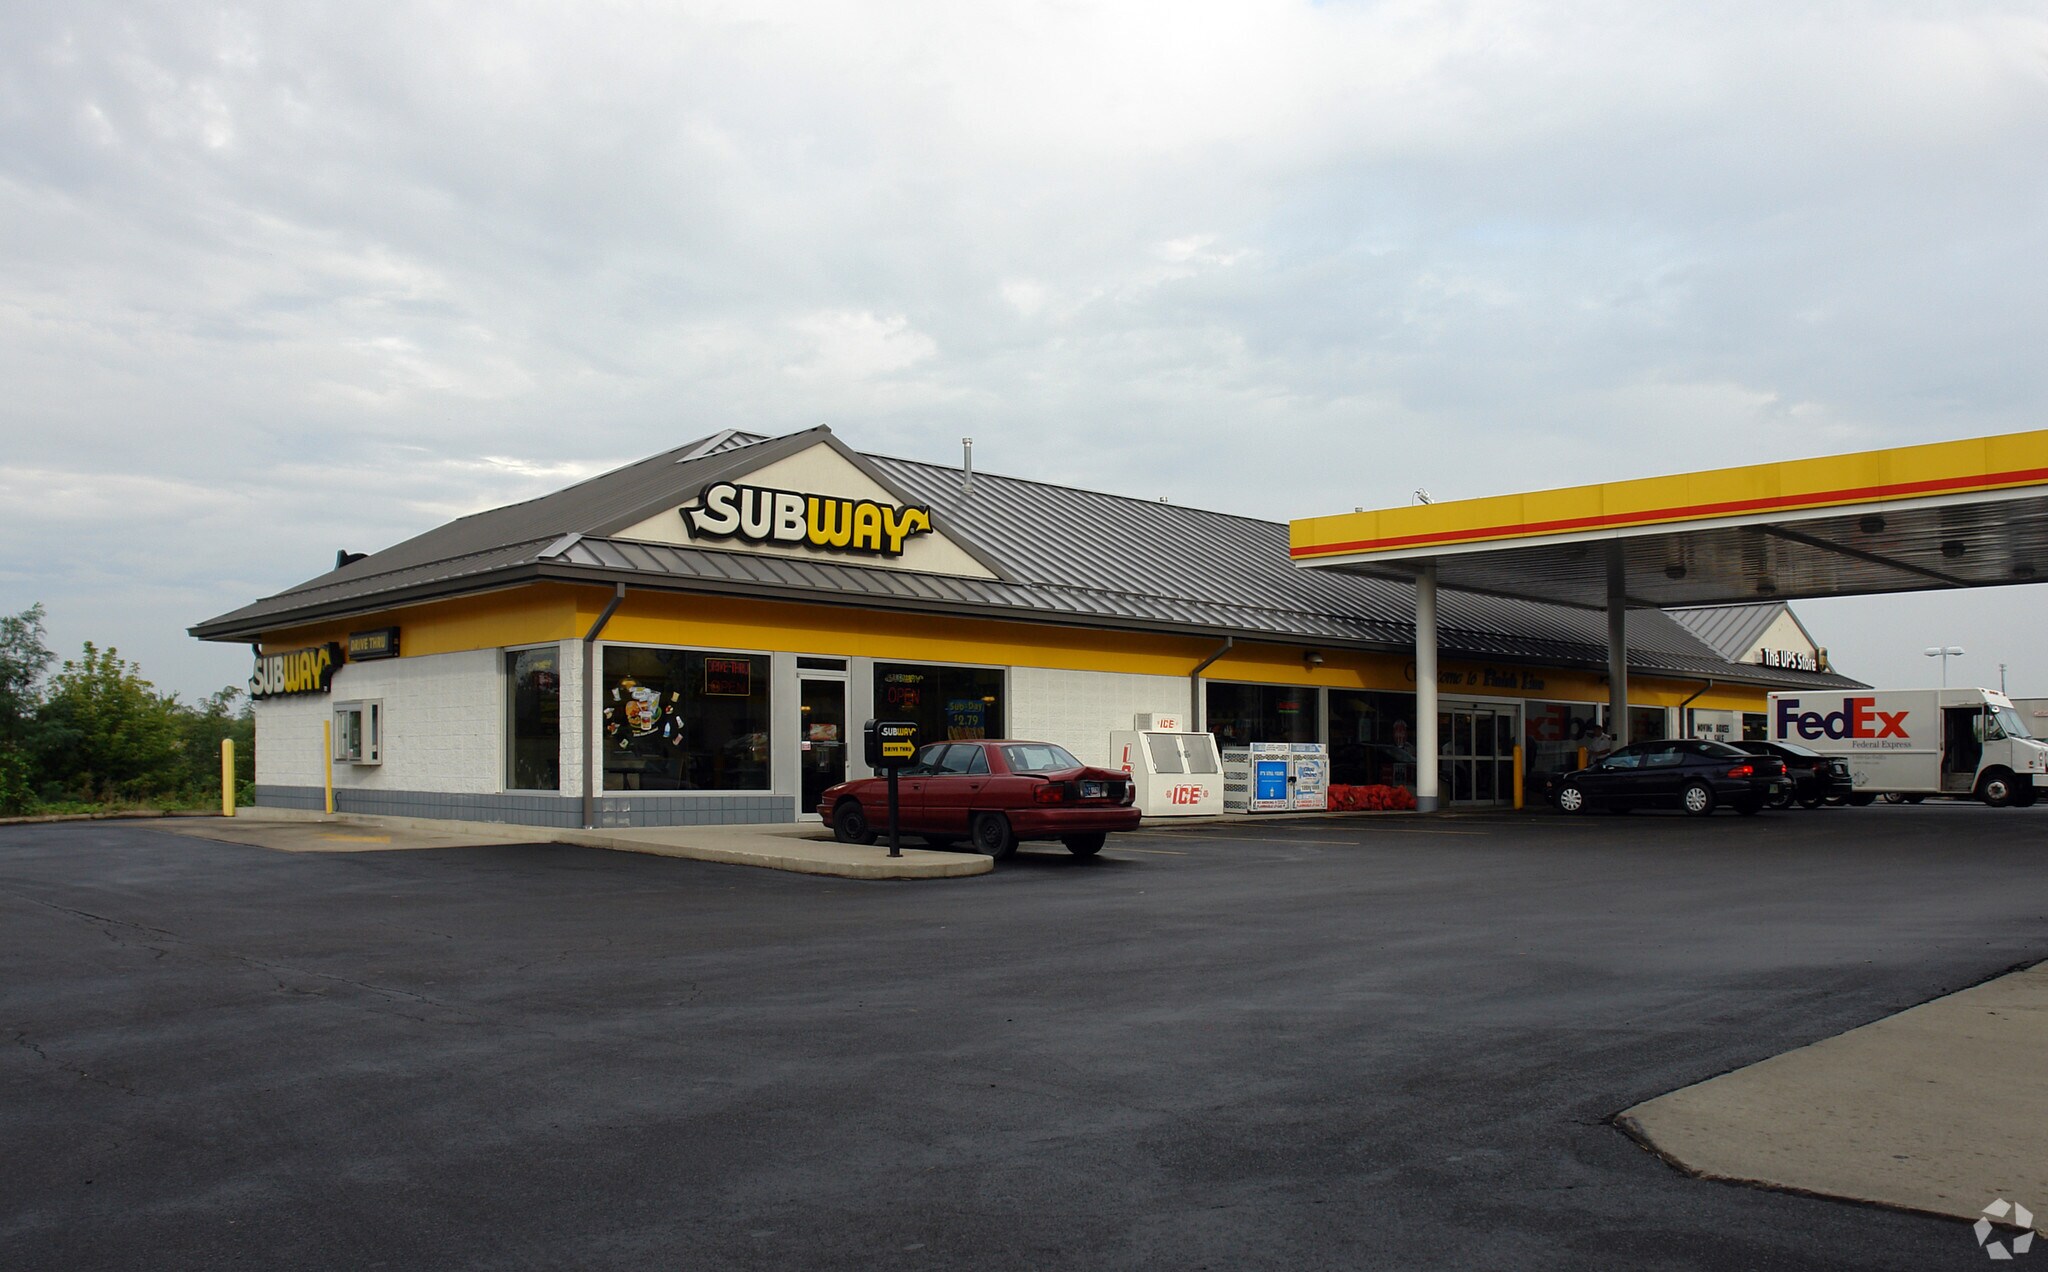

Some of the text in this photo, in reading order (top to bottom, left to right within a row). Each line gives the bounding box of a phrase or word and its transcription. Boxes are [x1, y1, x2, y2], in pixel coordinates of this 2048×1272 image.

[689, 484, 931, 552] SUBWAY
[350, 635, 386, 651] DRIVE THRU
[1764, 648, 1817, 672] The UPS Store
[250, 648, 332, 696] SUBWAY
[885, 673, 924, 684] SUBWAY
[887, 687, 920, 705] OPEN
[1159, 719, 1175, 729] ICE
[1777, 697, 1910, 740] FedEx
[881, 727, 917, 737] SUBWAY
[1852, 740, 1912, 750] Federal Express
[1172, 785, 1203, 805] ICE
